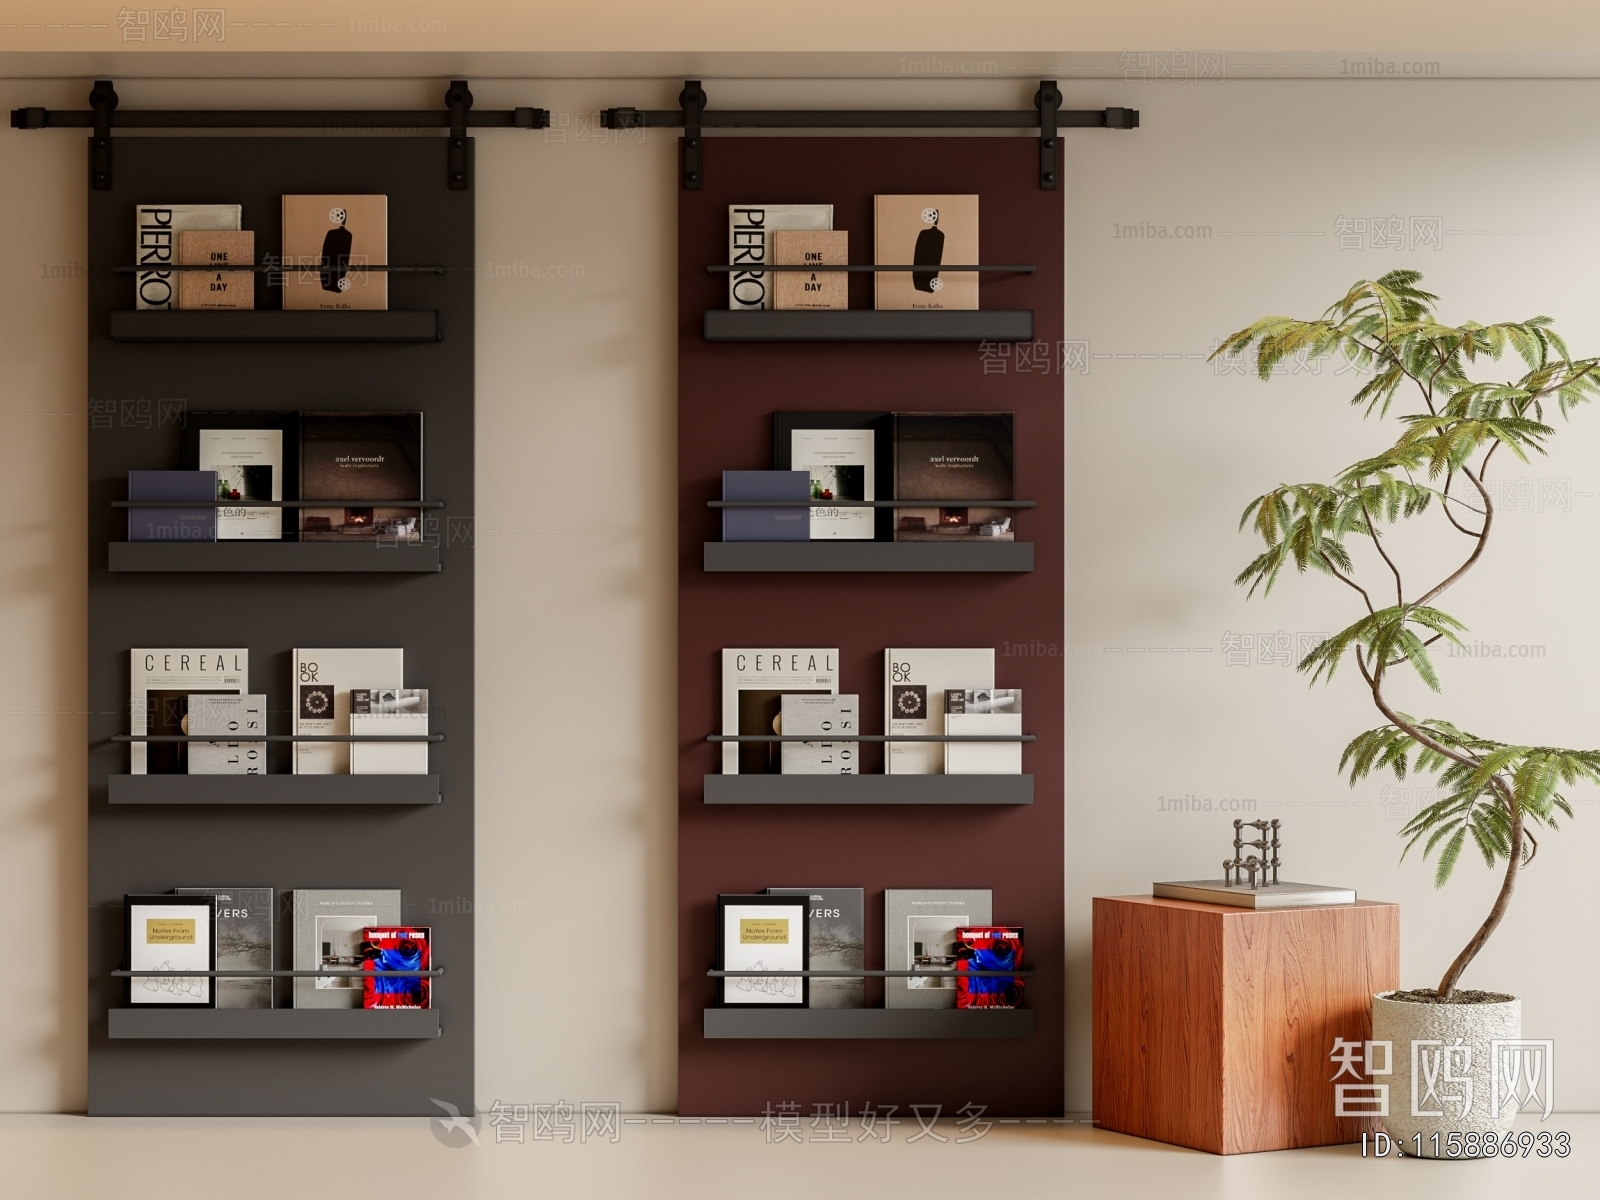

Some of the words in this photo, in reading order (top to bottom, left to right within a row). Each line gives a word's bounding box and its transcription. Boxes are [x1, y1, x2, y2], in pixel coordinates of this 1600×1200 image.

[210, 252, 228, 261] ONE
[805, 252, 823, 261] ONE
[216, 273, 222, 282] A
[811, 273, 817, 282] A
[210, 283, 228, 292] DAY
[804, 283, 822, 292] DAY
[335, 455, 350, 463] axel
[351, 455, 385, 463] vervoordt
[930, 455, 945, 463] axel
[946, 455, 980, 463] vervoordt
[145, 654, 242, 672] CEREAL
[300, 662, 319, 673] BO
[736, 654, 834, 672] CEREAL
[892, 662, 911, 673] BO
[300, 671, 319, 683] OK
[892, 671, 911, 683] OK
[390, 931, 397, 939] of
[397, 931, 408, 939] red
[408, 931, 425, 939] roses
[984, 931, 991, 939] of
[1002, 931, 1019, 939] roses
